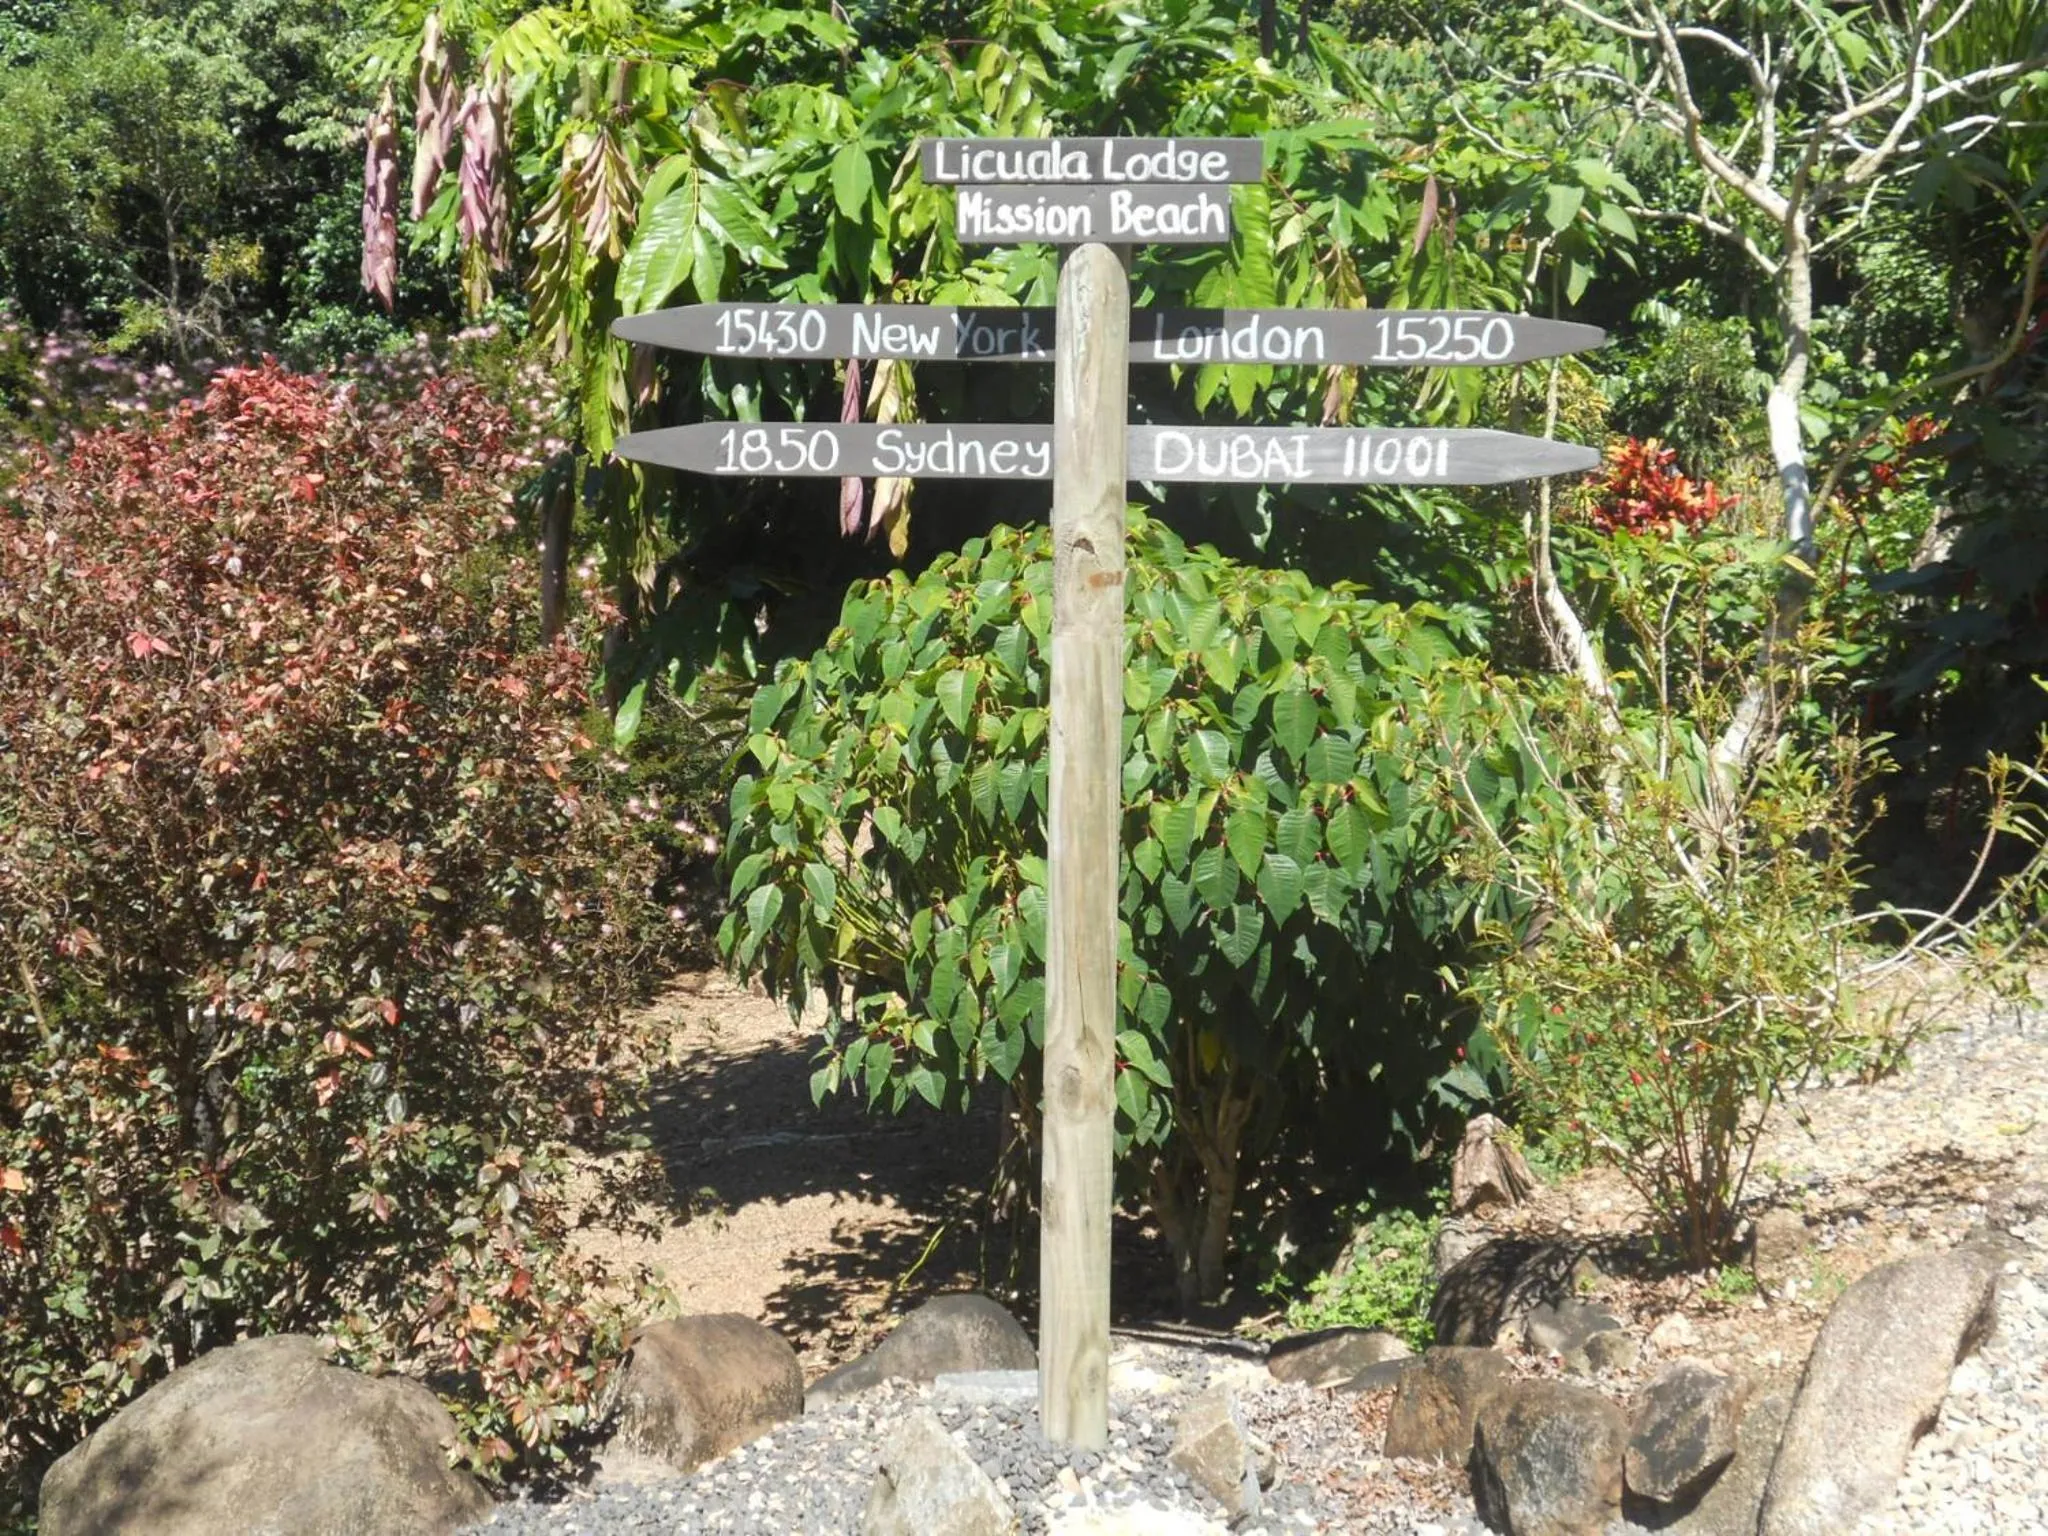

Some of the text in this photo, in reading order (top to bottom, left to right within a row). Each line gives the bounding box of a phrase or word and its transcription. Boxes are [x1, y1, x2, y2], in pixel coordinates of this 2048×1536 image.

[936, 139, 1231, 182] Licuala Lodge
[957, 189, 1226, 237] Mission Beach
[714, 308, 1046, 359] 15430 New York
[1152, 312, 1515, 361] London 15250
[871, 430, 1051, 477] Sydney
[1153, 430, 1449, 478] DUBAI 11001
